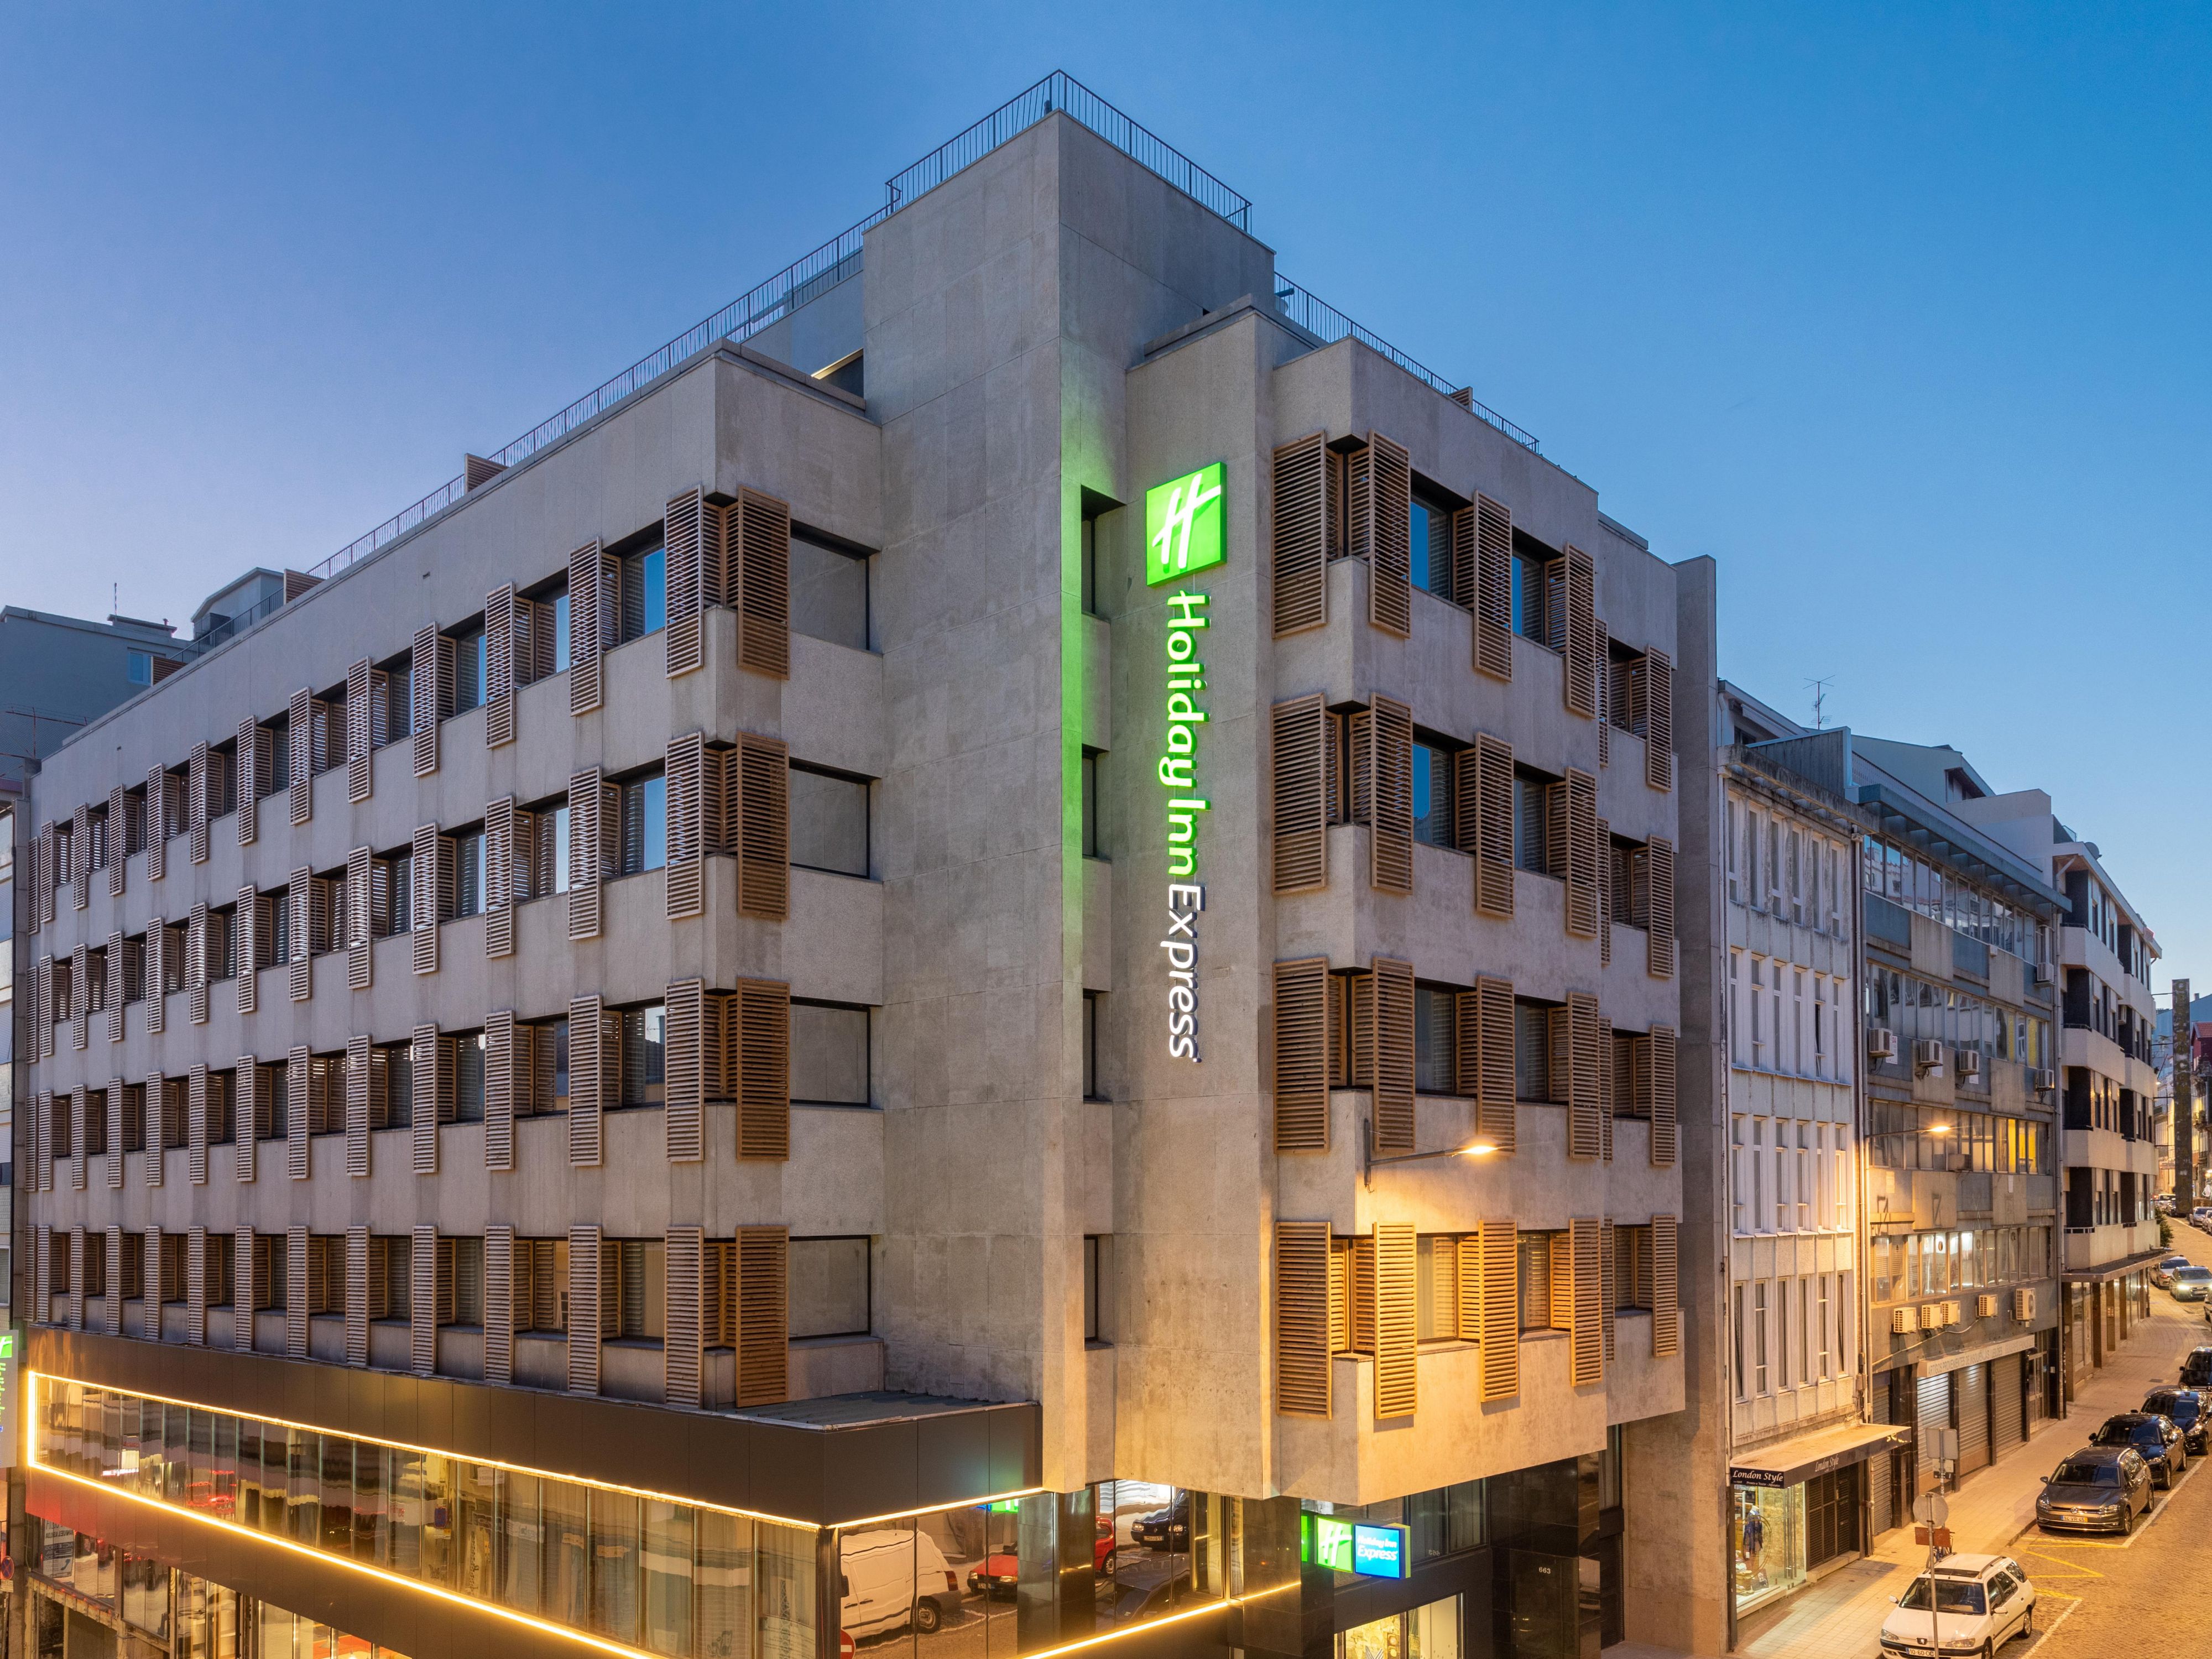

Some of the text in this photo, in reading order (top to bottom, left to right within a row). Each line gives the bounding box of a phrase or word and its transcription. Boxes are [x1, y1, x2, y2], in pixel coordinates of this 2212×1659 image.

[1159, 590, 1210, 1058] Holiday Inn Express
[1733, 1470, 1783, 1483] London Style
[1357, 1535, 1397, 1548] Holiday Inn
[1358, 1544, 1397, 1561] Express
[1539, 1566, 1551, 1574] 663
